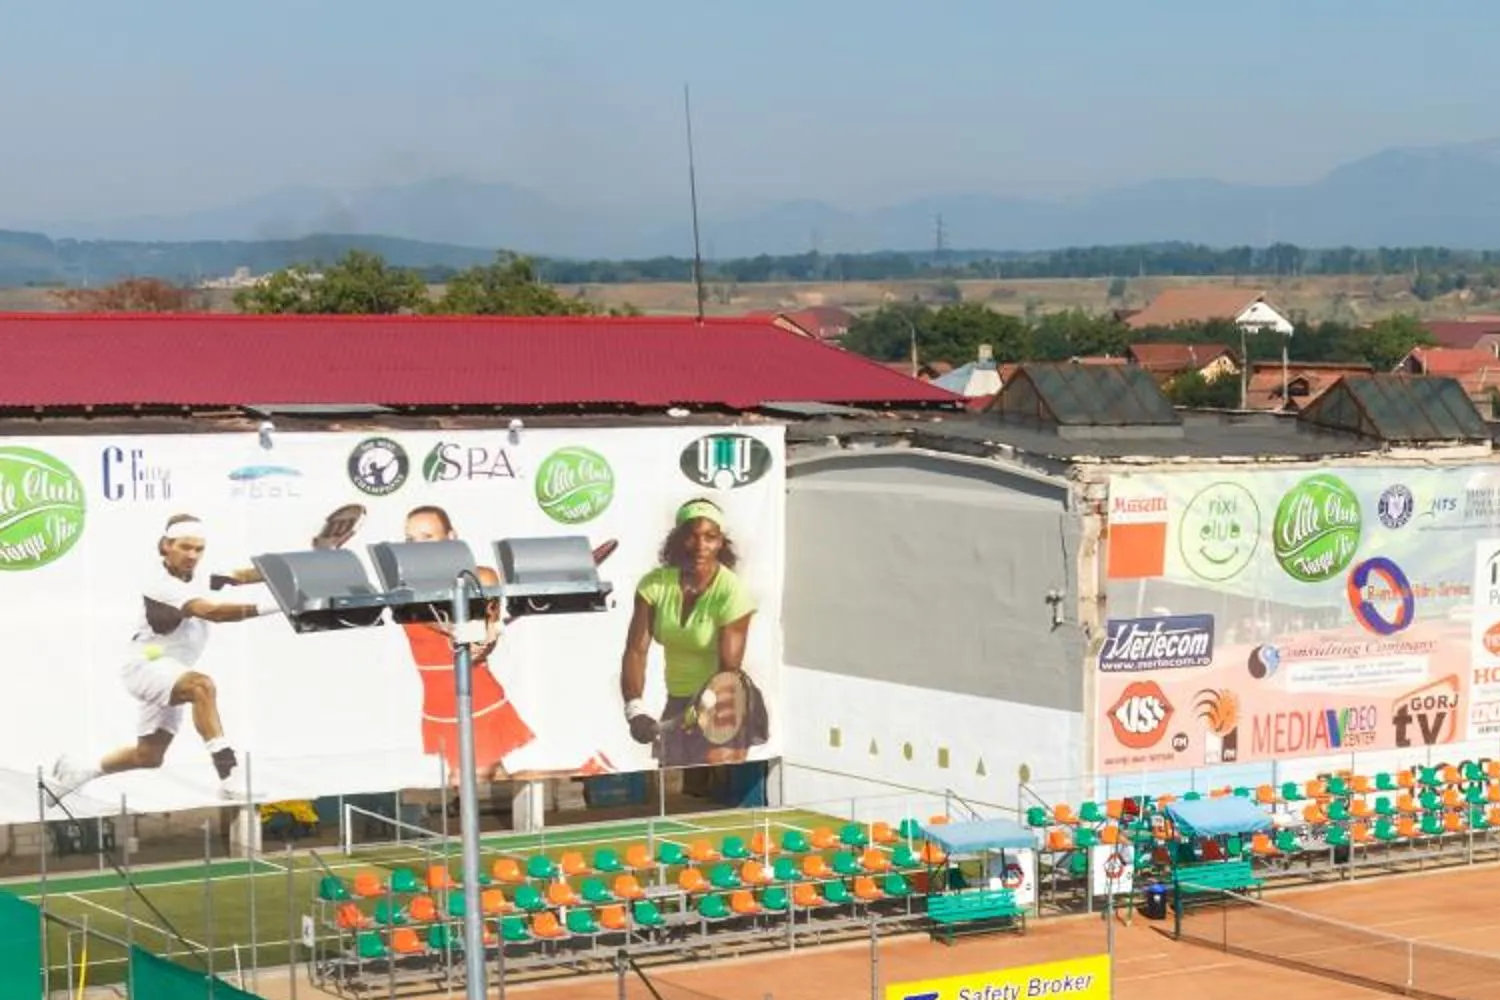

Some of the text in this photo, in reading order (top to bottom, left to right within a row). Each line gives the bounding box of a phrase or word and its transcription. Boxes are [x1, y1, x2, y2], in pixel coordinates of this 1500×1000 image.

[440, 443, 514, 480] SPA
[1411, 694, 1459, 711] GORJ
[1252, 709, 1329, 754] MEDIA
[1392, 703, 1447, 747] tv
[1027, 974, 1094, 998] Broker
